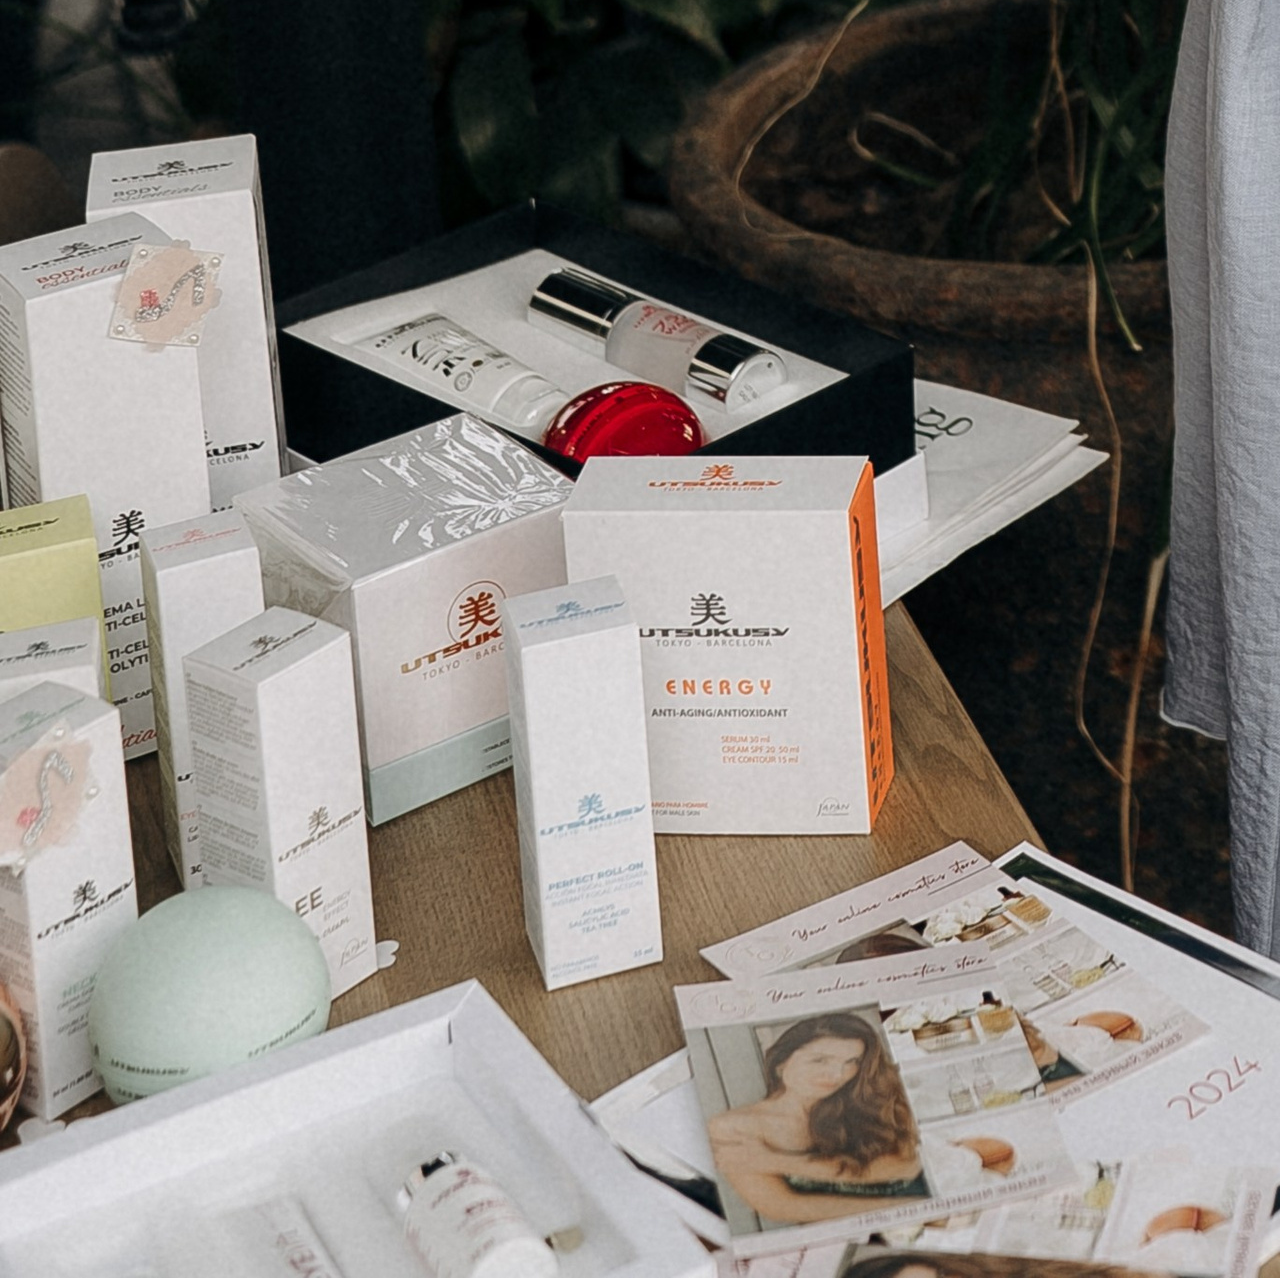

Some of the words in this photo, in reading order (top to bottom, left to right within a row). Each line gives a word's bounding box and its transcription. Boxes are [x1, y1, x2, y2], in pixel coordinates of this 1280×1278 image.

[36, 266, 85, 284] BODY
[104, 602, 134, 619] EMA
[639, 627, 790, 638] UTSUKUSY
[656, 639, 692, 647] TOKYO
[706, 639, 772, 647] BARCELONA
[422, 659, 460, 681] TOKYO
[666, 679, 771, 696] ENERGY
[651, 708, 788, 718] ANTI-AGING/ANTIOXIDANT
[548, 873, 594, 891] PERFECT
[792, 923, 828, 941] Your
[838, 906, 882, 924] online
[887, 873, 946, 902] cosmetics
[948, 858, 980, 874] store
[767, 988, 806, 1004] Your
[816, 977, 869, 994] online
[877, 963, 948, 983] cosmetics
[954, 956, 989, 972] store
[1167, 1055, 1262, 1120] 2024
